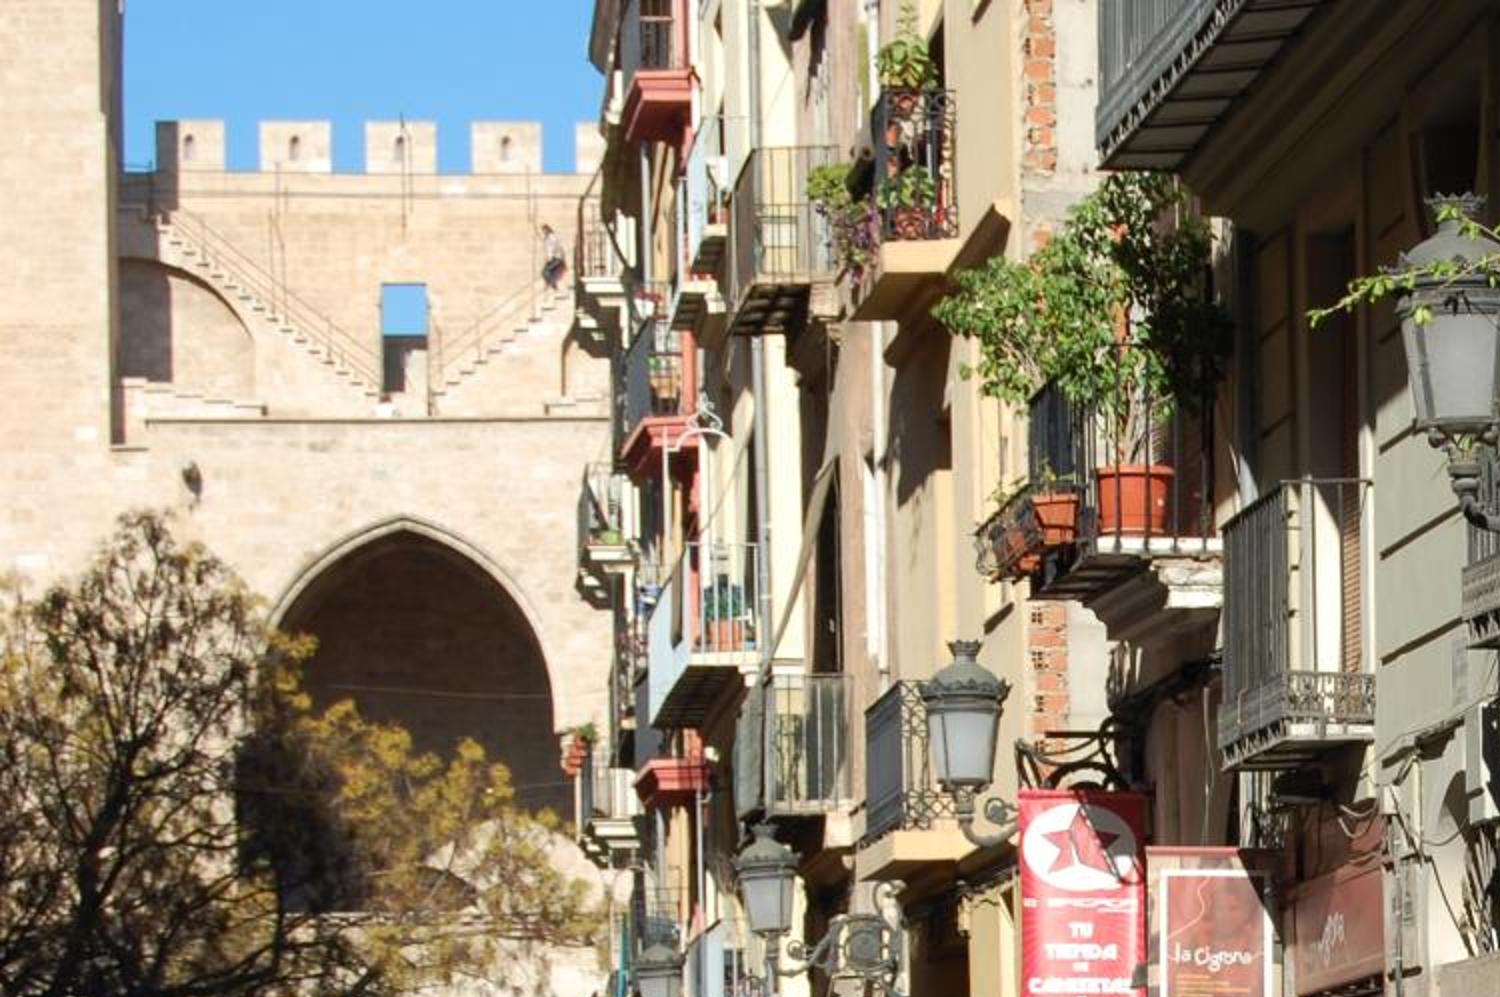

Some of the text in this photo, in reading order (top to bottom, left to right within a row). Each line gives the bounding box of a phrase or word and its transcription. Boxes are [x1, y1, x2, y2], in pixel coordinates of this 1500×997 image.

[1068, 921, 1095, 939] TU
[1044, 943, 1119, 960] TIENDA
[1175, 942, 1193, 964] la
